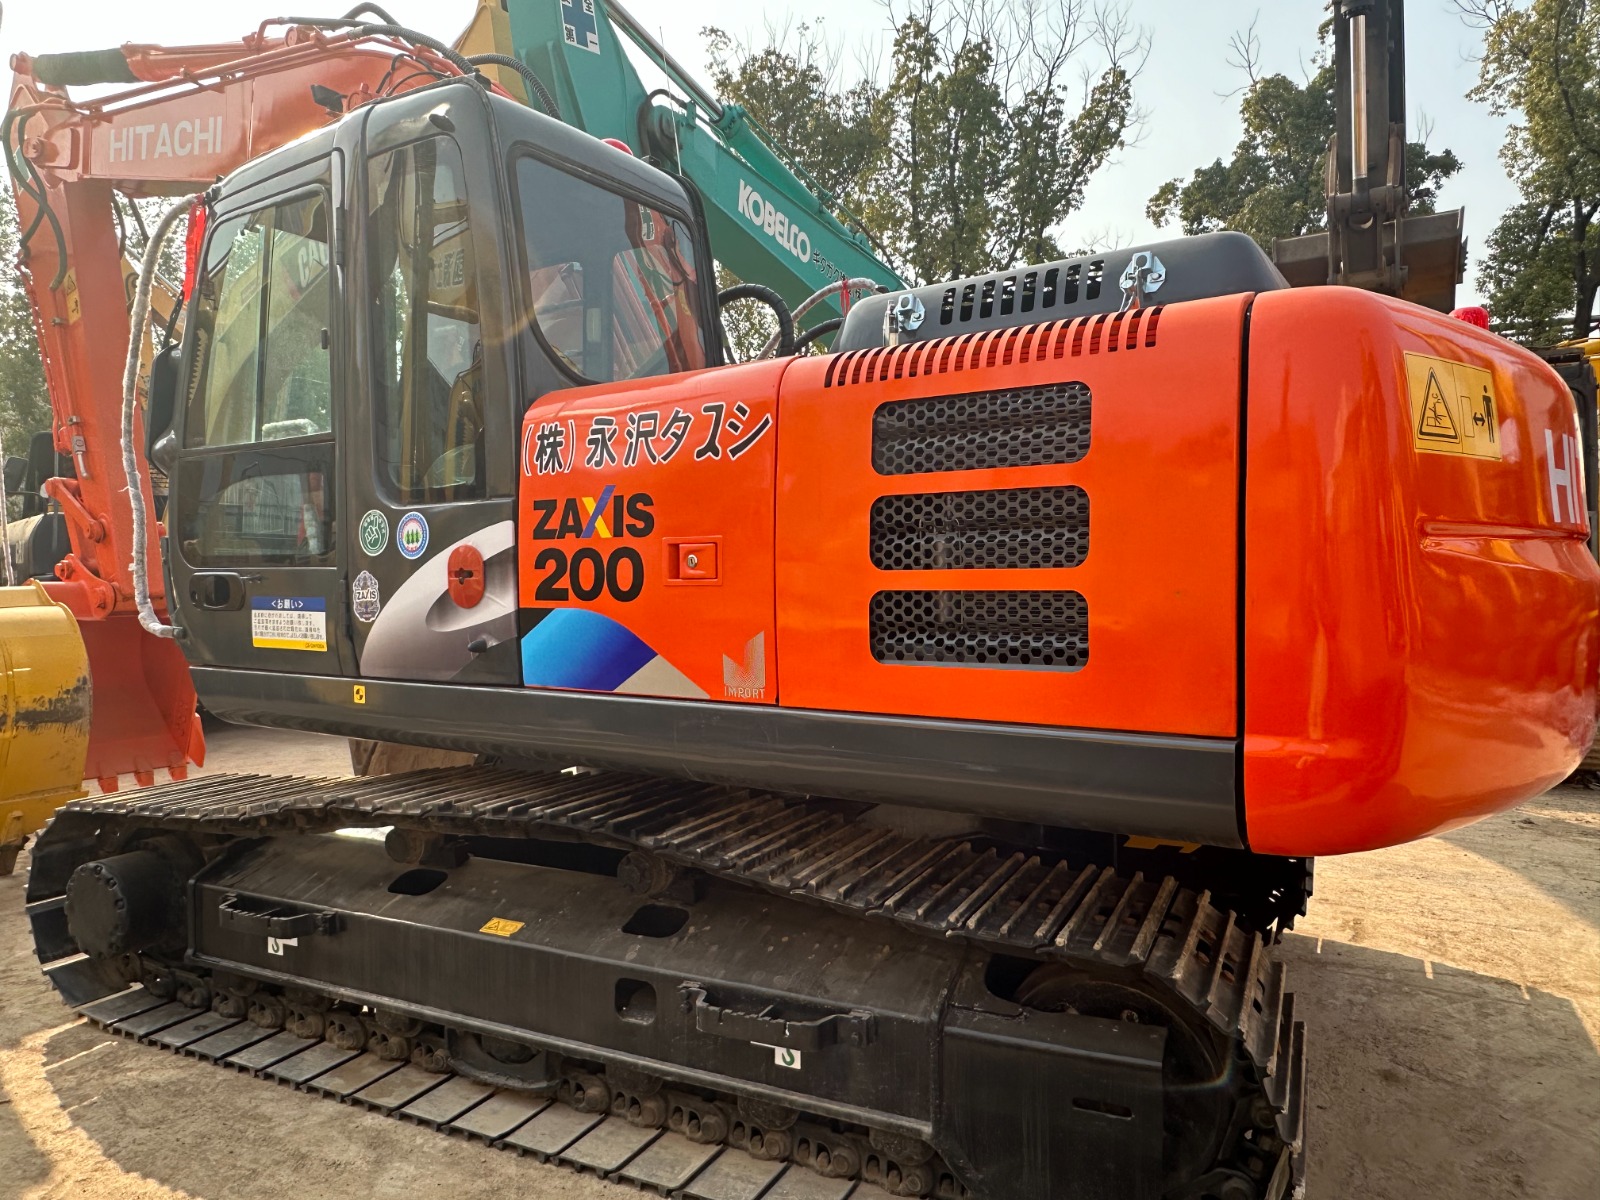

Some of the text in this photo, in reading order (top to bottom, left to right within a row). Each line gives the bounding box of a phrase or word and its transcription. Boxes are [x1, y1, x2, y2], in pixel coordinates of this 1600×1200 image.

[109, 115, 223, 163] HITACHI
[737, 178, 811, 263] KOBELCO
[532, 485, 655, 540] ZAXIS
[533, 546, 645, 602] 200
[724, 685, 765, 699] IMPORT
